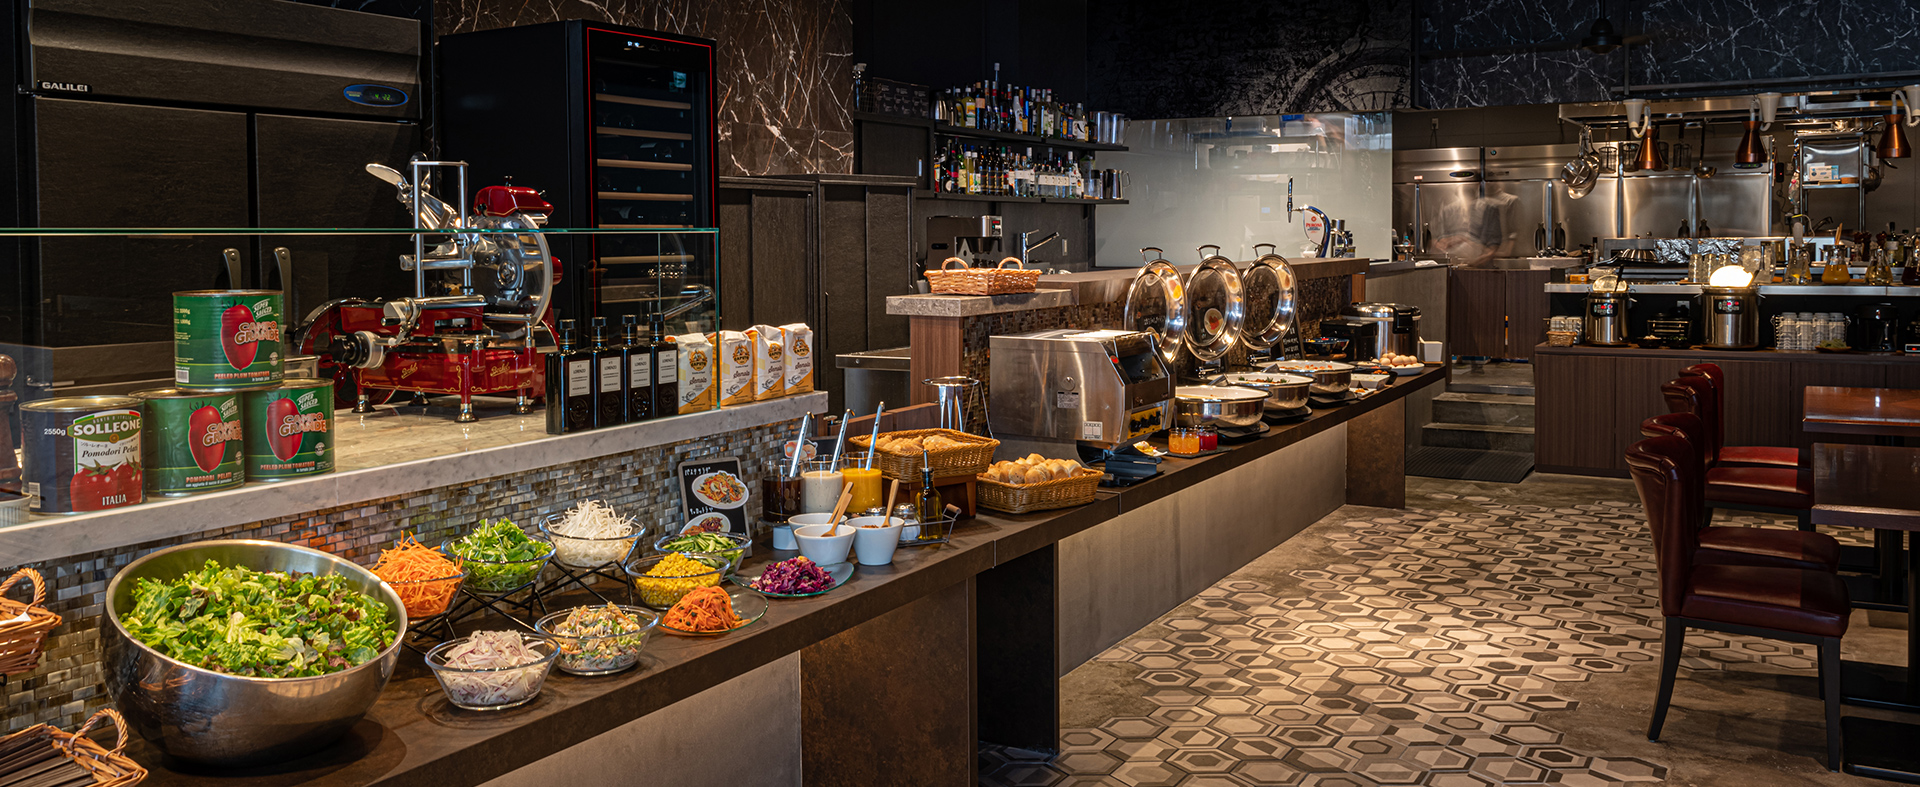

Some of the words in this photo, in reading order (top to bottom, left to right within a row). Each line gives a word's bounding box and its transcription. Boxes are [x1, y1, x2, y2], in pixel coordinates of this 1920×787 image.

[42, 81, 88, 92] GALILEI
[253, 301, 269, 313] SUPER
[239, 320, 278, 334] CAMPO
[234, 329, 280, 344] GRANDE
[298, 393, 314, 405] SUPER
[301, 398, 319, 409] SAUCED
[283, 412, 324, 424] CAMPO
[44, 428, 66, 436] 2550g
[73, 418, 141, 436] SOLLEONE
[207, 419, 240, 433] CAMPO
[279, 420, 327, 437] GRANDE
[203, 428, 243, 447] GRANDE
[82, 446, 121, 458] Pomodori
[122, 443, 138, 454] Pelati
[186, 474, 215, 483] POMODORI
[217, 472, 232, 480] PELATI
[102, 493, 127, 506] ITALIA
